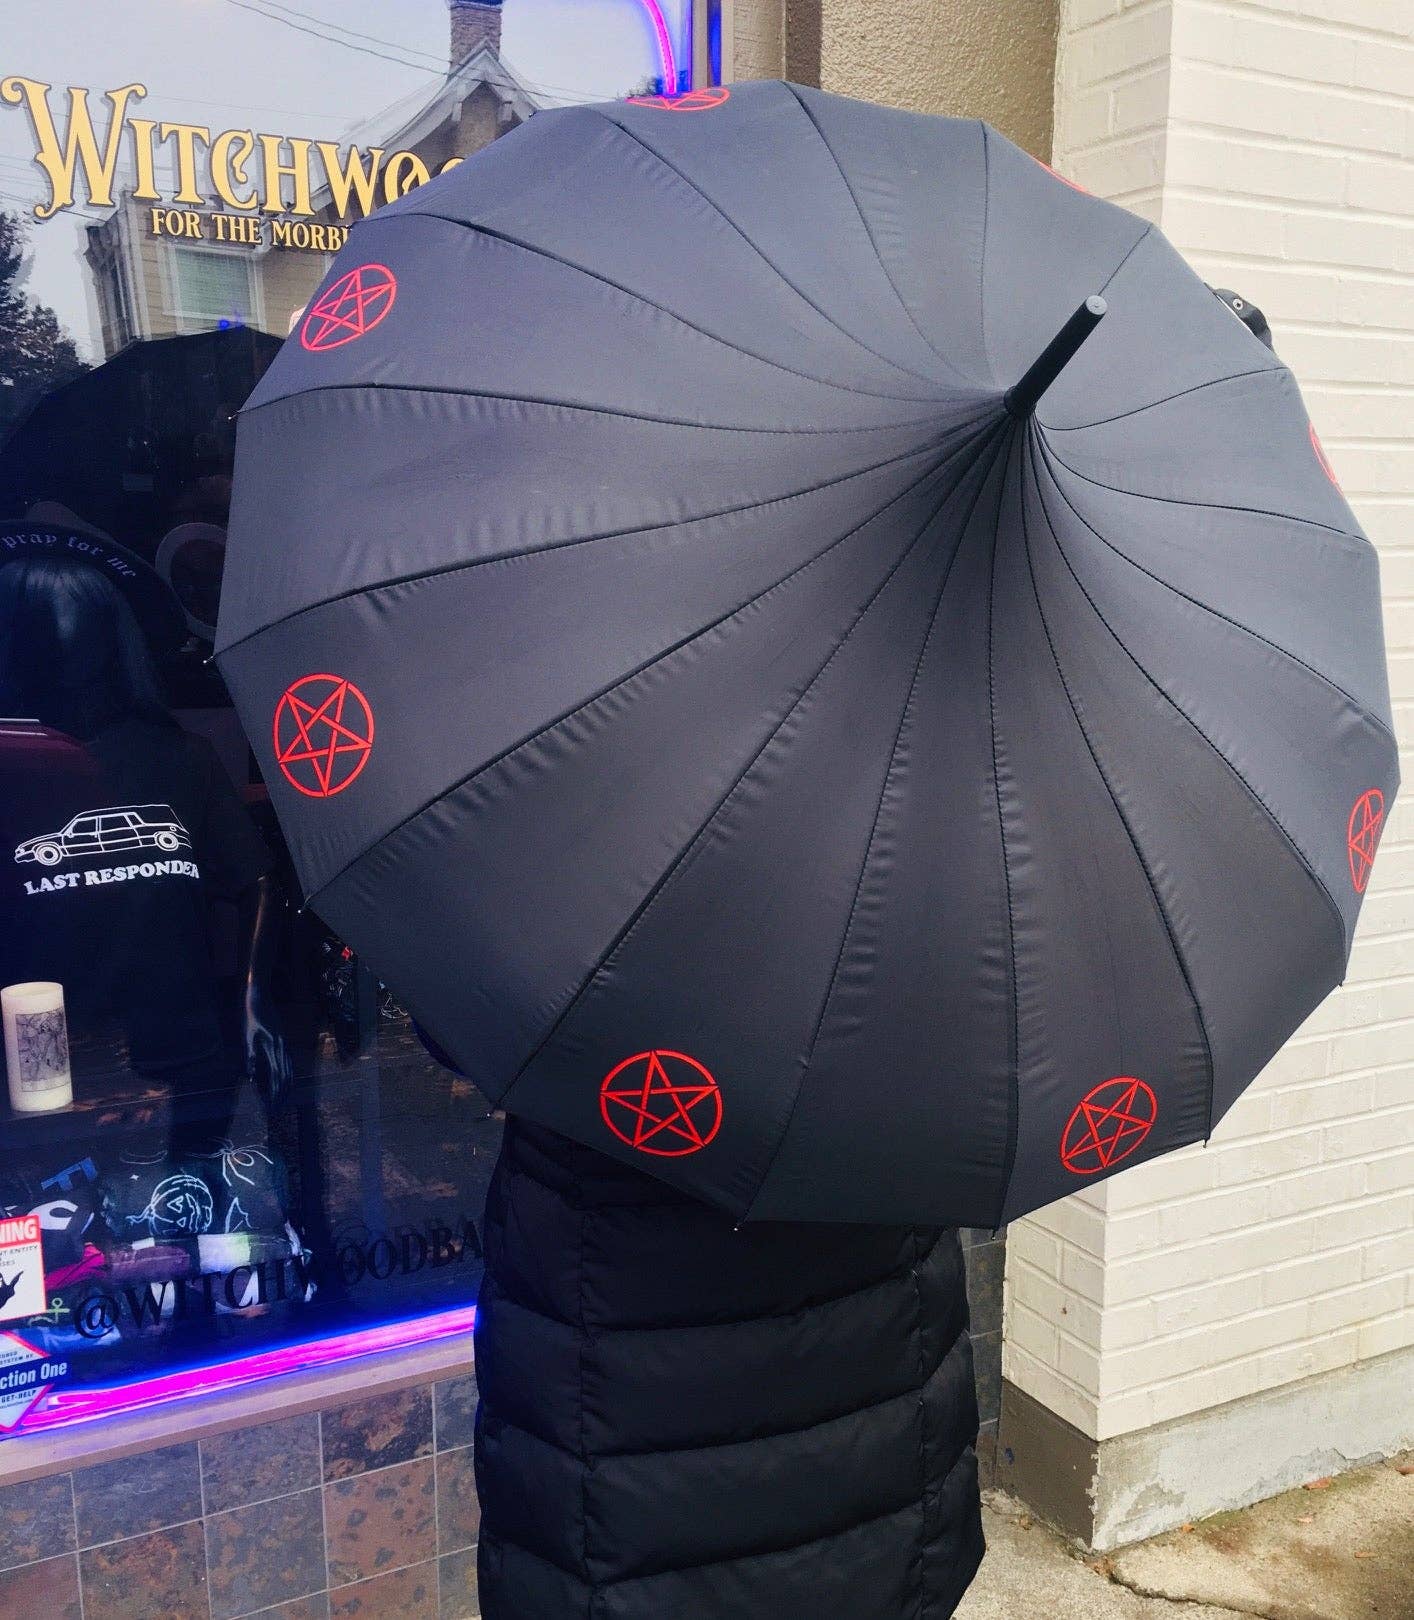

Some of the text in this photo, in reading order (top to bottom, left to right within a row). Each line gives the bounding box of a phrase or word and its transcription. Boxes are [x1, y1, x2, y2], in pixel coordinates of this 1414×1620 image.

[1, 77, 466, 219] WITCHWO
[151, 208, 202, 239] FOR
[211, 214, 262, 244] THE
[1, 533, 57, 549] pray
[67, 536, 104, 556] for
[24, 860, 200, 895] LAST RESPONDER
[40, 1362, 68, 1380] One
